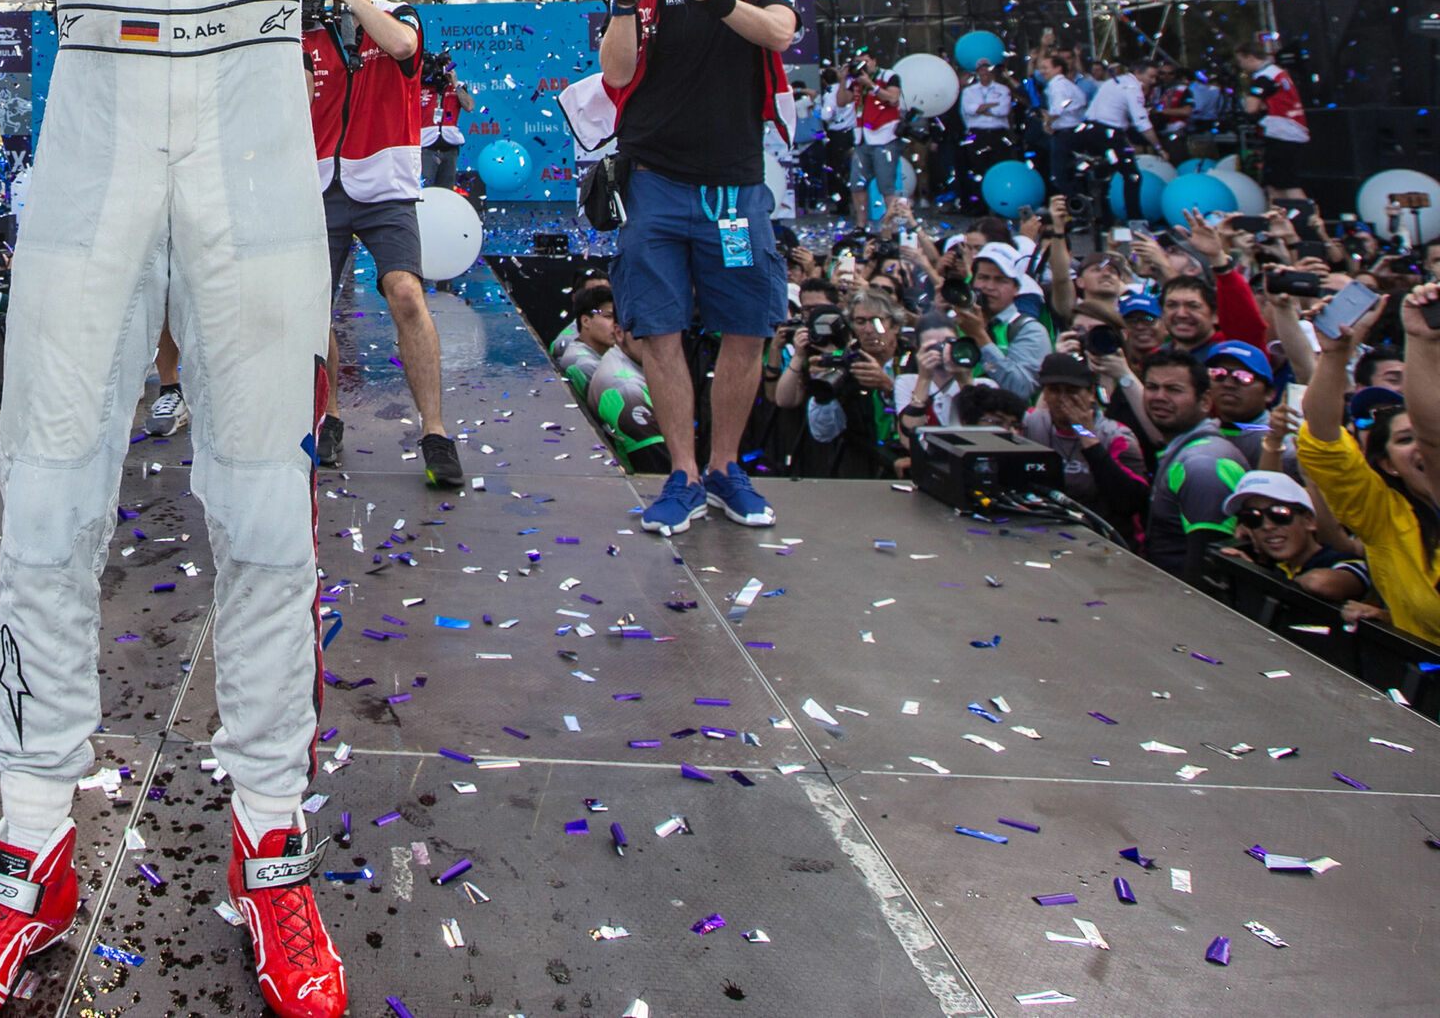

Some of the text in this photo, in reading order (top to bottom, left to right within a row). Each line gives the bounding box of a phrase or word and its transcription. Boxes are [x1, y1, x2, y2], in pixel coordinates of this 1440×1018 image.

[195, 23, 226, 39] Abt
[441, 25, 494, 37] MEXICO
[538, 78, 569, 91] ABB
[468, 122, 501, 135] ABB
[524, 122, 559, 135] Julius
